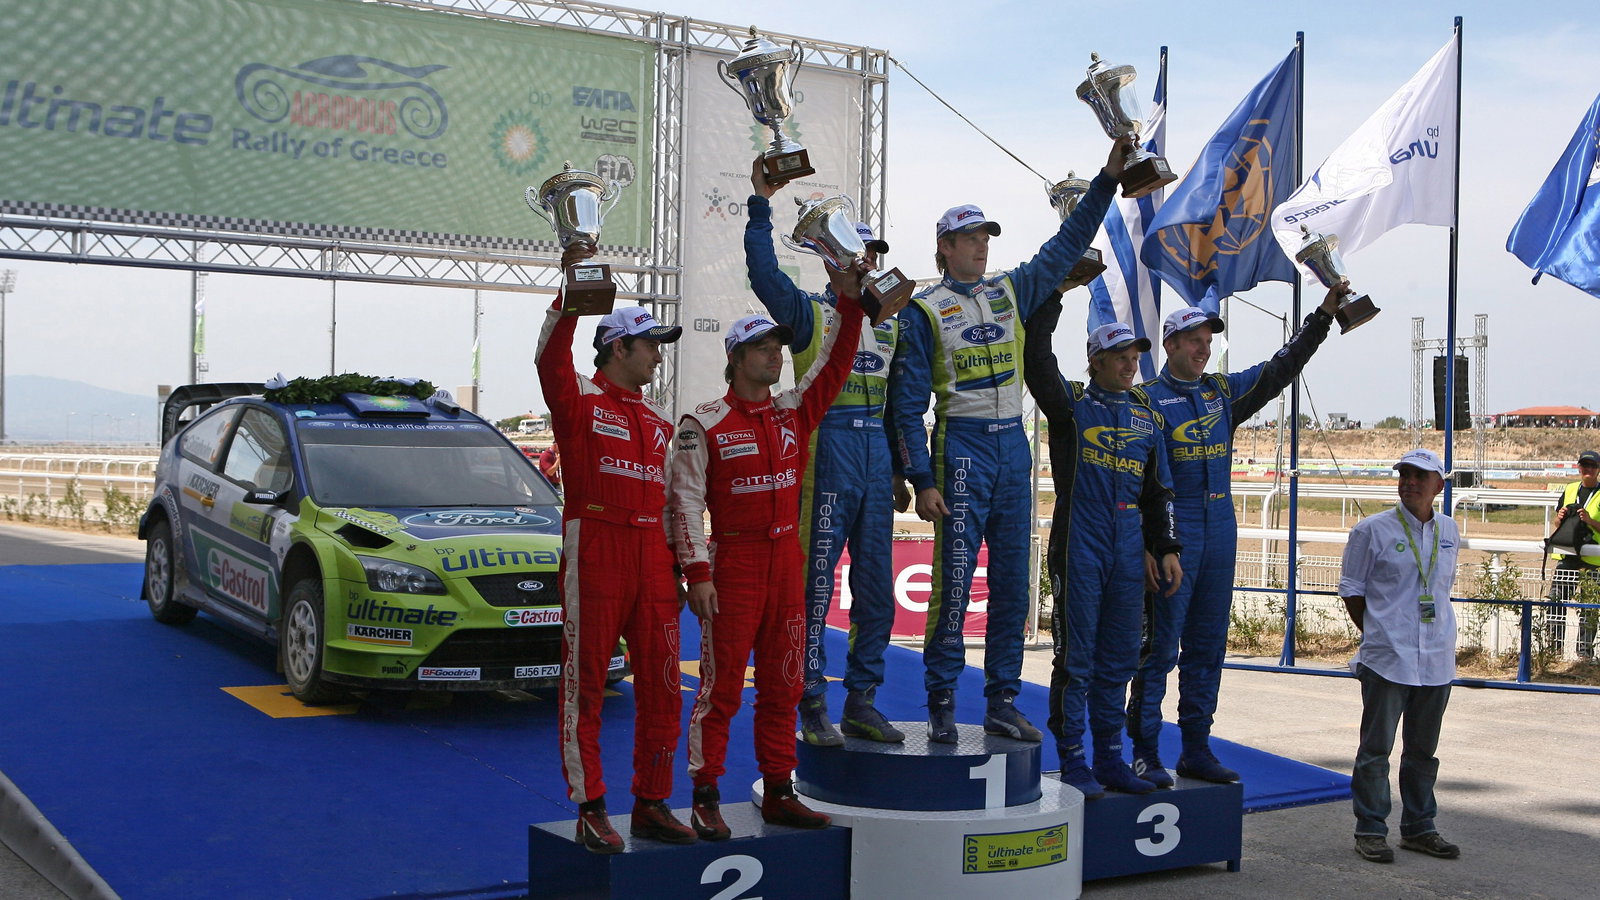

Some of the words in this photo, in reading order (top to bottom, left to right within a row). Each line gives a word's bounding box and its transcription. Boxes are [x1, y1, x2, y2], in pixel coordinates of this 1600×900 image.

[528, 86, 551, 111] bp
[0, 79, 214, 146] ltimate
[290, 91, 397, 135] ACROPOLIS
[581, 115, 637, 135] WRC
[232, 128, 307, 160] Rally
[313, 134, 342, 159] of
[350, 139, 448, 169] Greece
[971, 327, 998, 341] Ford
[955, 353, 964, 361] bp
[956, 351, 1014, 371] ultimate
[343, 422, 370, 430] Feel
[373, 422, 394, 430] the
[603, 412, 627, 425] TOTAL
[594, 423, 629, 437] BFGoodrich
[727, 432, 754, 440] TOTAL
[722, 445, 757, 458] BFGoodrich
[1082, 447, 1145, 472] SUBARU
[1173, 442, 1228, 457] SUBARU
[600, 456, 665, 476] CITROË
[731, 468, 797, 488] CITROË
[954, 457, 971, 496] Feel
[434, 511, 528, 526] Ford
[819, 492, 837, 533] Feel
[953, 501, 969, 532] the
[434, 547, 456, 555] bp
[441, 546, 562, 572] ultima
[816, 537, 832, 570] the
[220, 559, 266, 611] Castrol
[522, 580, 543, 590] Ford
[948, 535, 967, 631] difference
[347, 599, 458, 627] ultimate
[809, 575, 831, 670] difference
[354, 626, 412, 641] KÄRCHER
[382, 665, 404, 674] PUMA
[516, 667, 540, 678] EJ56
[541, 665, 561, 677] FZV
[565, 620, 578, 703] CITROËN
[422, 668, 478, 679] BFGoodrich
[968, 753, 1007, 809] 1
[1134, 802, 1181, 857] 3
[966, 837, 978, 871] 2007
[988, 845, 1034, 858] ultimate
[699, 854, 764, 900] 2
